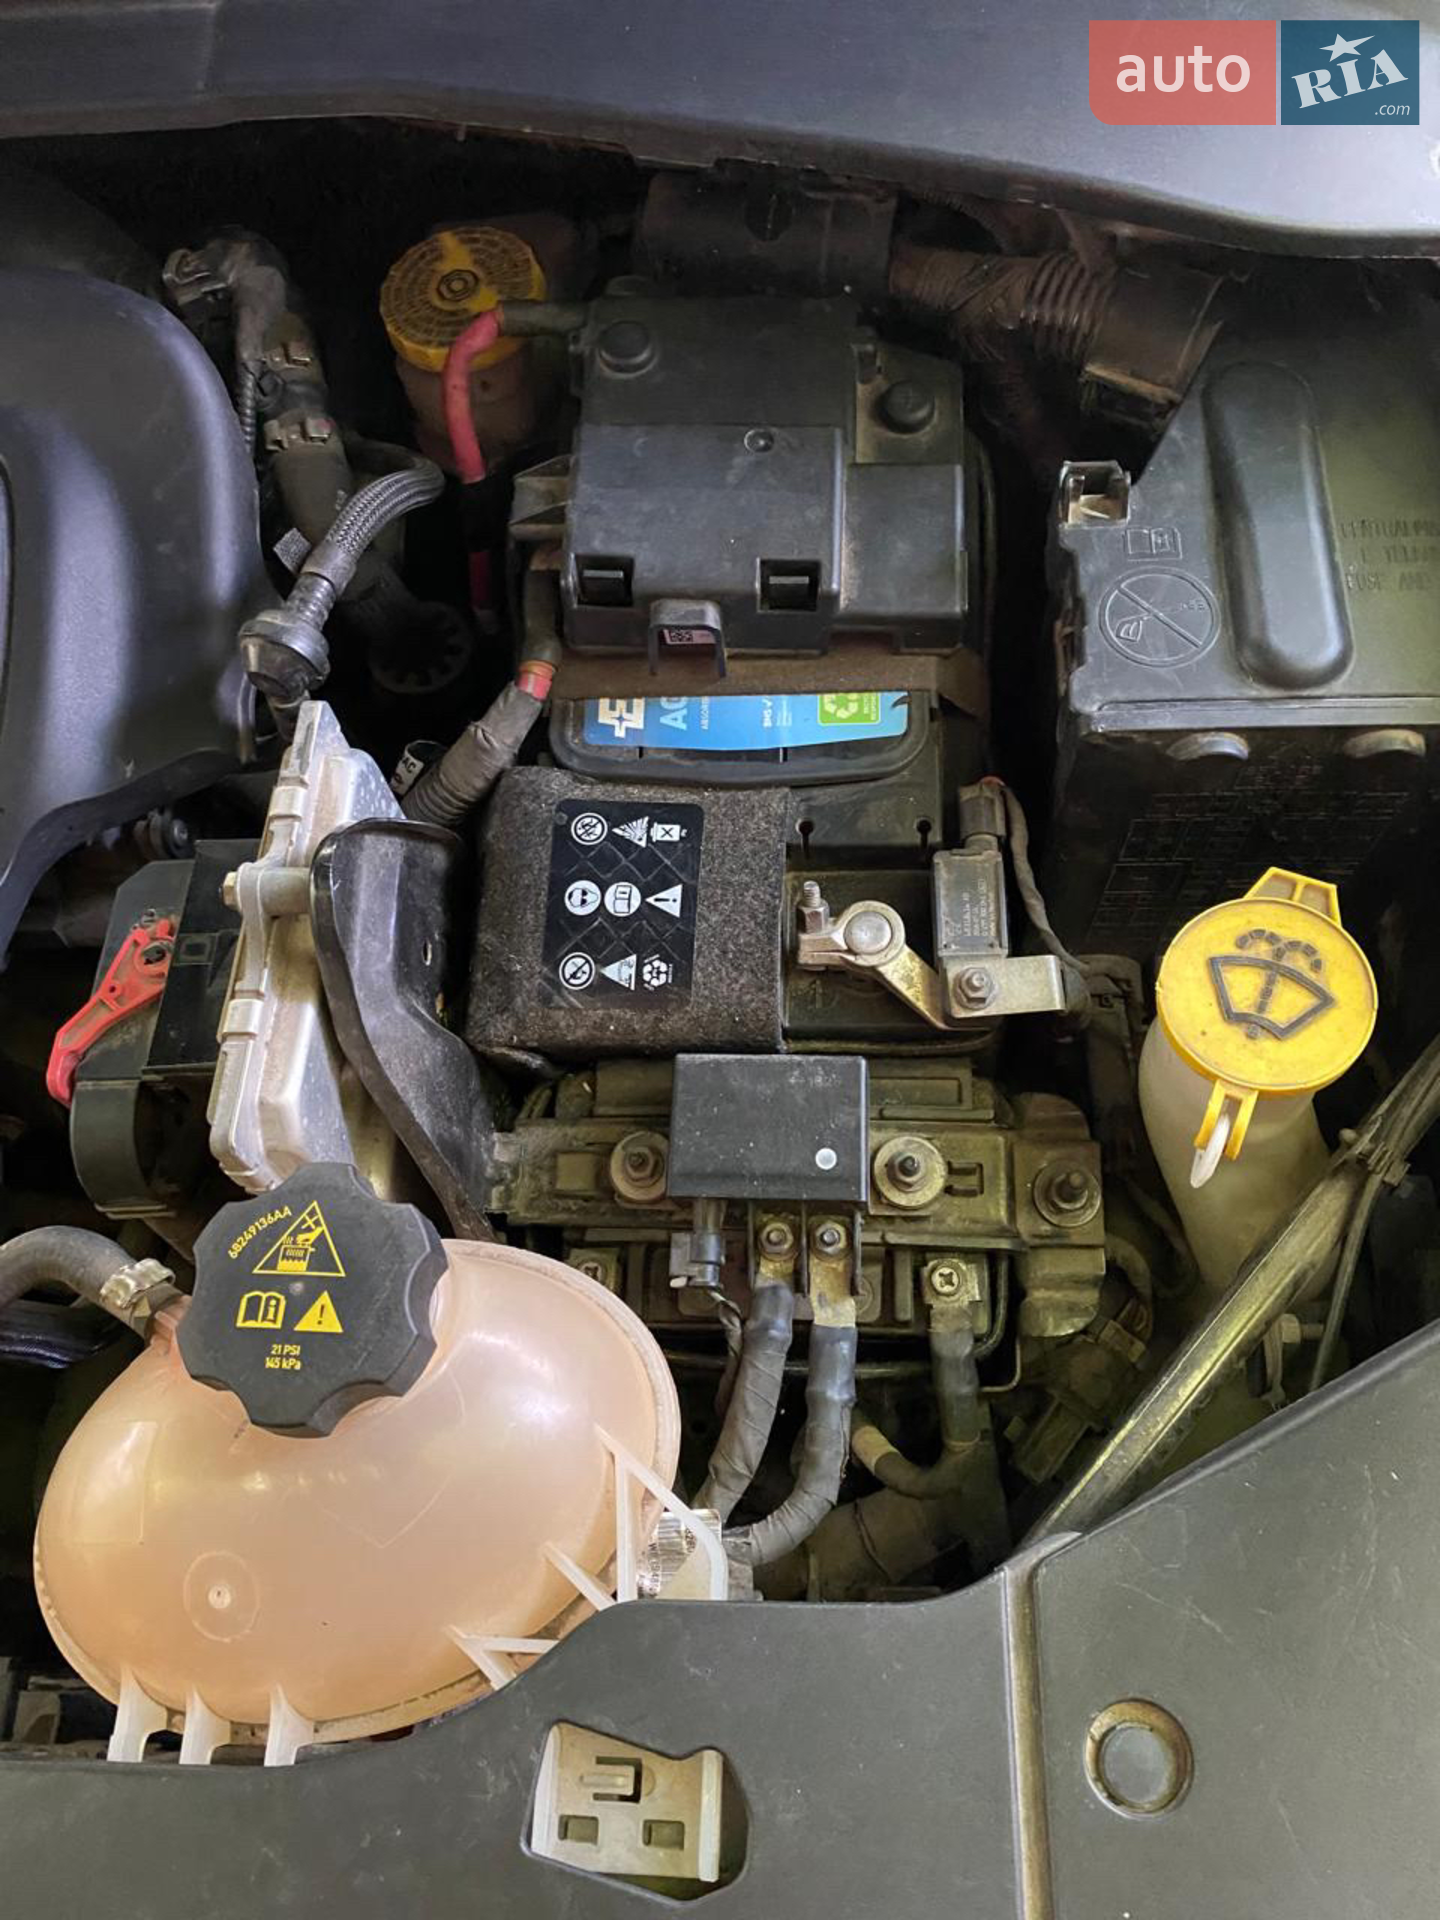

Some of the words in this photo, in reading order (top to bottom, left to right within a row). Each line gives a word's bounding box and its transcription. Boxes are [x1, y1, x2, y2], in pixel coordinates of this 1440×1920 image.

[227, 1205, 293, 1260] 68249136AA
[271, 1344, 282, 1355] 21
[283, 1344, 301, 1356] PSI
[281, 1357, 301, 1370] kPa
